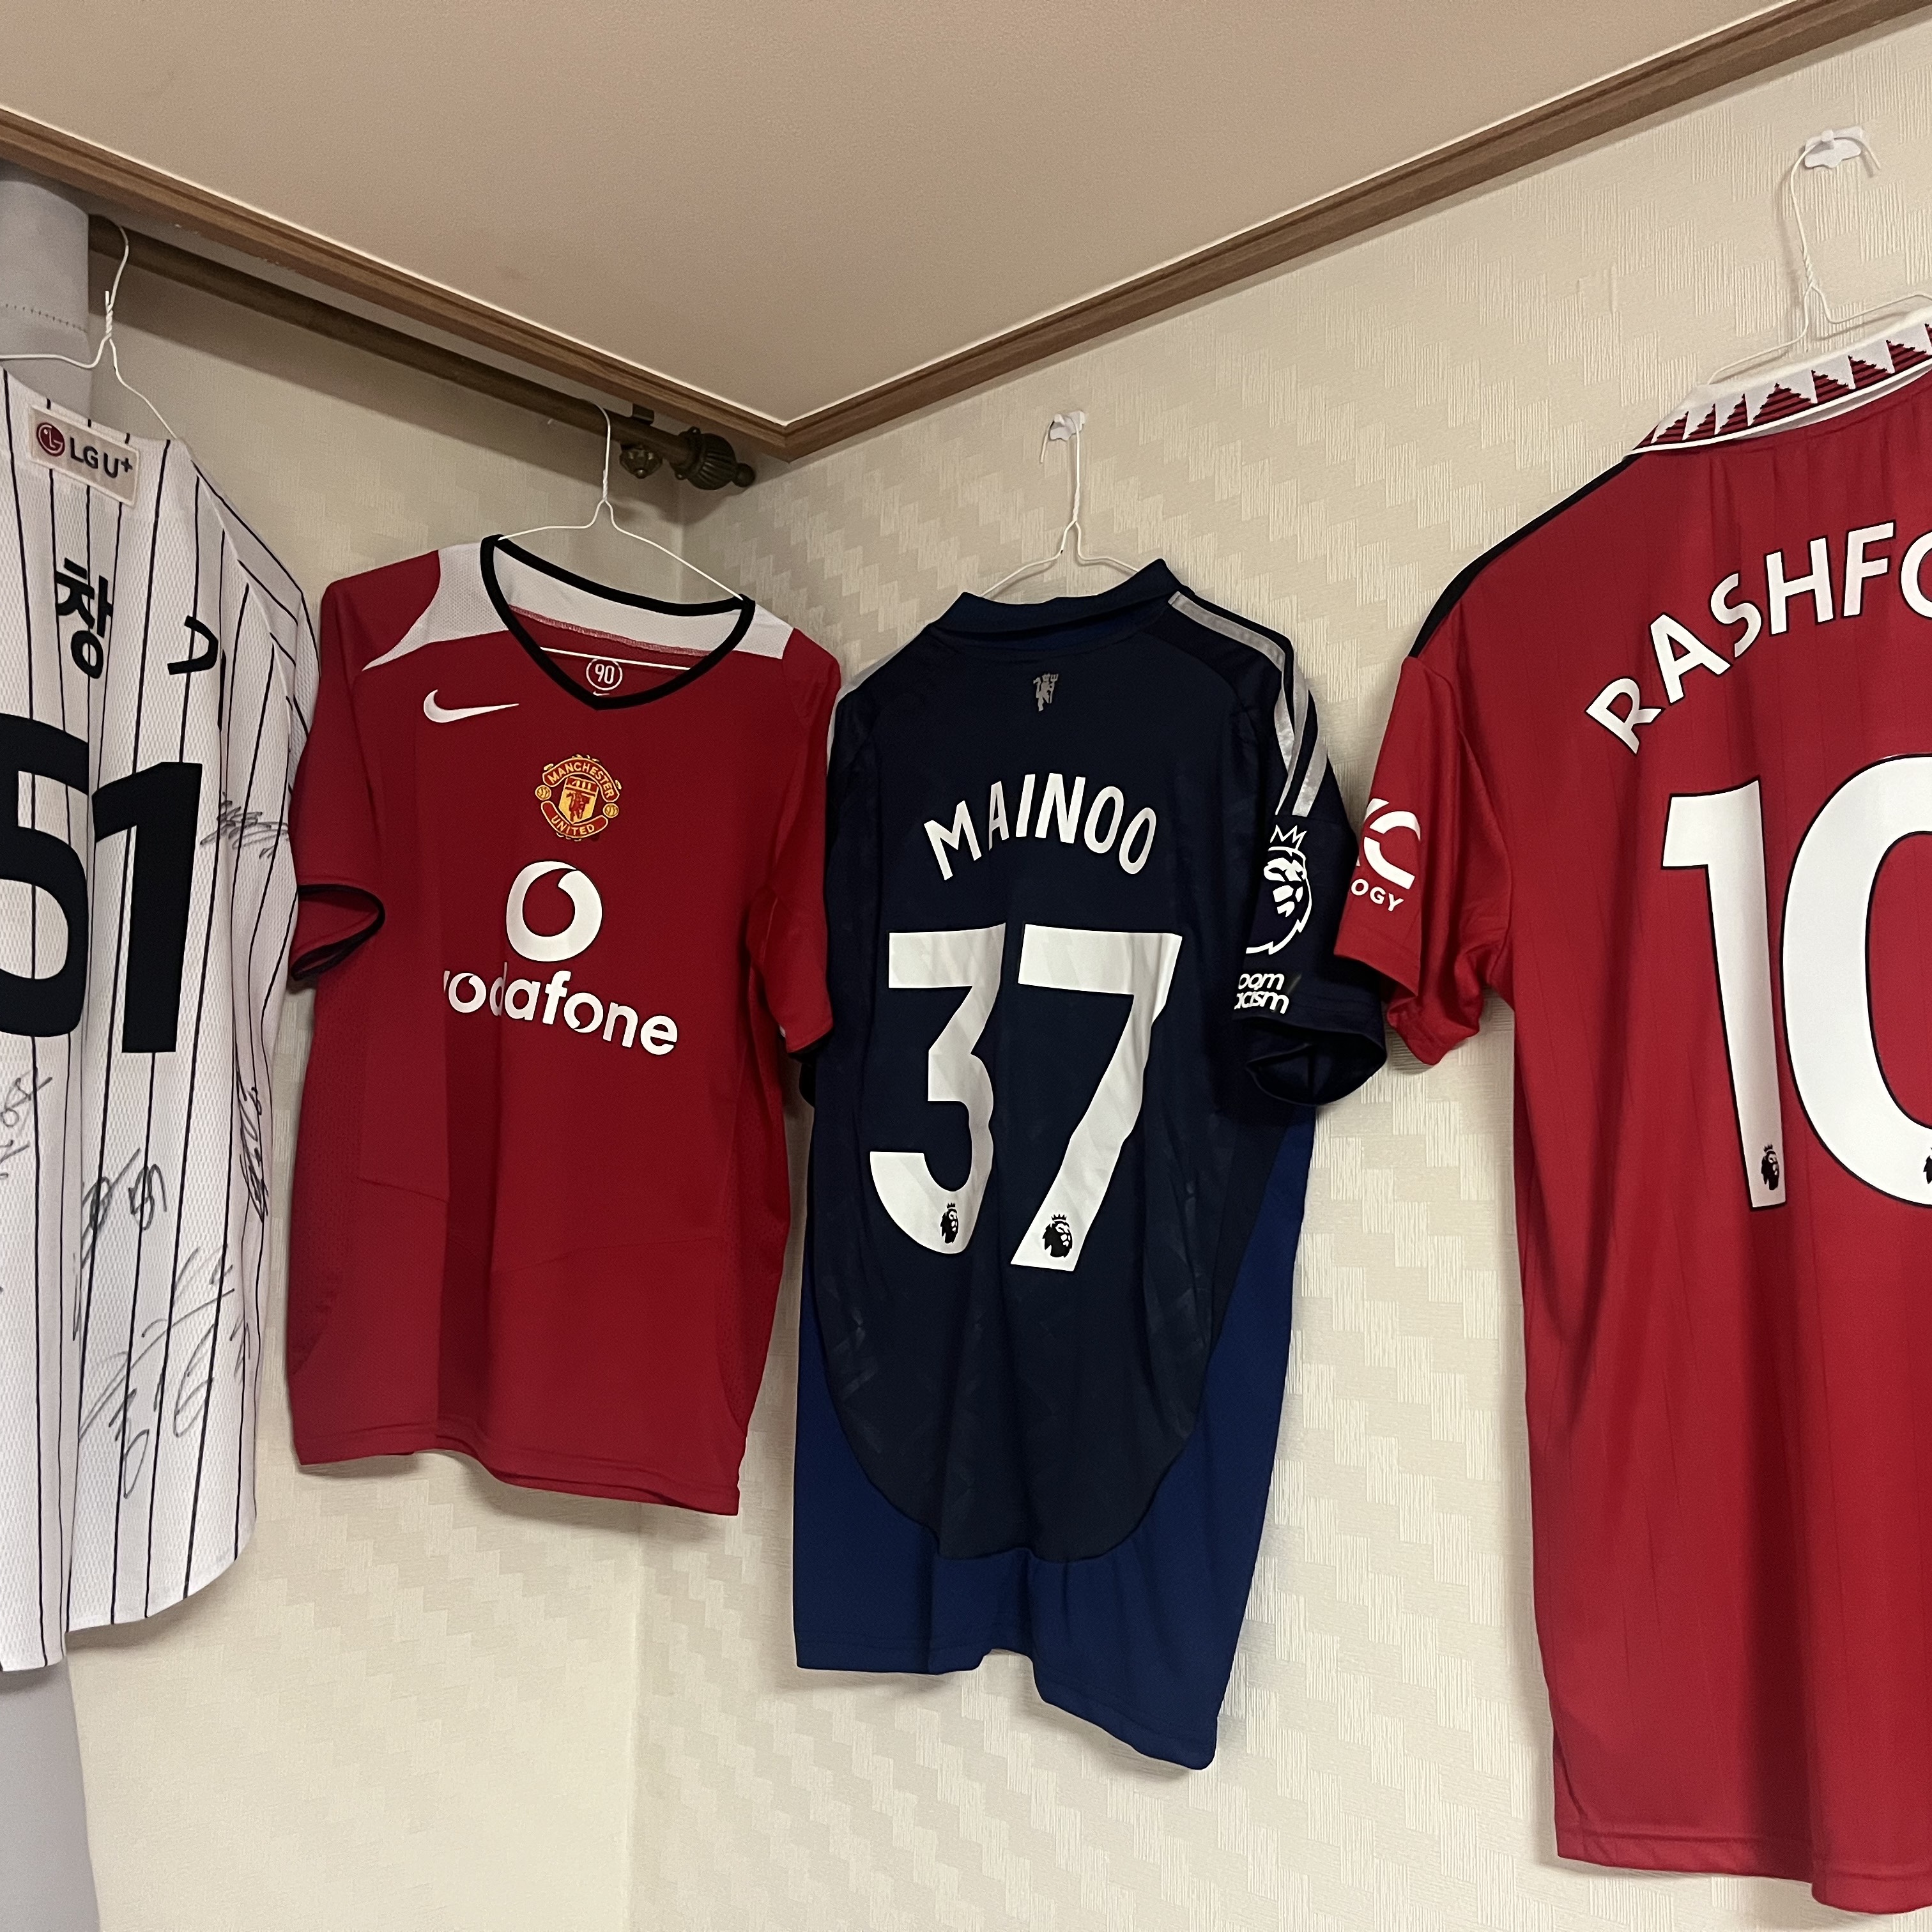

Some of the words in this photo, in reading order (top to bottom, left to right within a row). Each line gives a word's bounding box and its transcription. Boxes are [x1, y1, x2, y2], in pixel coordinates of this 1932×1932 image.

[70, 436, 98, 469] LG
[103, 452, 133, 479] U+
[595, 663, 615, 684] 90
[547, 762, 615, 799] MANCHESTER
[551, 815, 595, 836] UNITED
[924, 773, 1156, 881] MAINOO
[1351, 878, 1404, 912] OGY
[870, 923, 1182, 1272] 37
